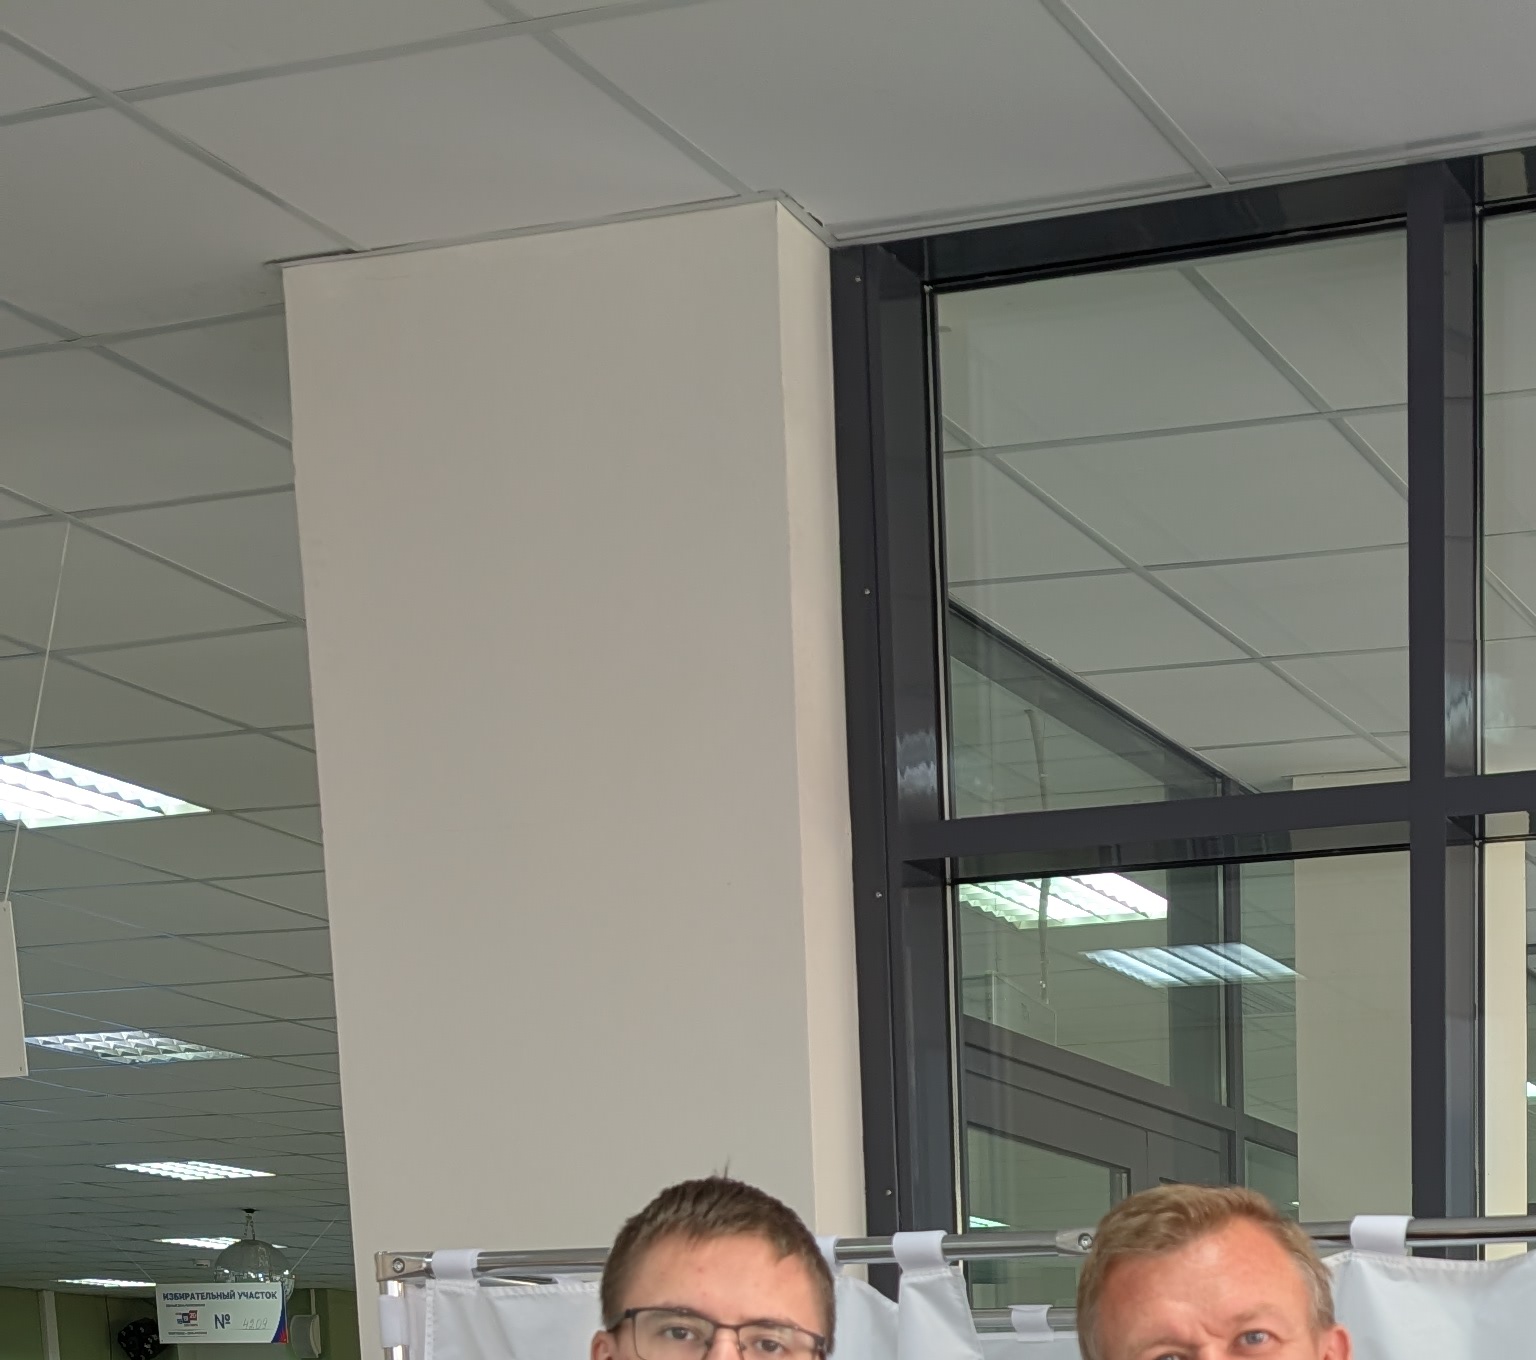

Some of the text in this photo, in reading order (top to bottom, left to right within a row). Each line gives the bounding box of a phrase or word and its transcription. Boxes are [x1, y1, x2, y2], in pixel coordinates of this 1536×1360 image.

[162, 1290, 278, 1301] ИЗБИРАТЕЛЬНЫЙ УЧАСТОК
[214, 1314, 231, 1330] №
